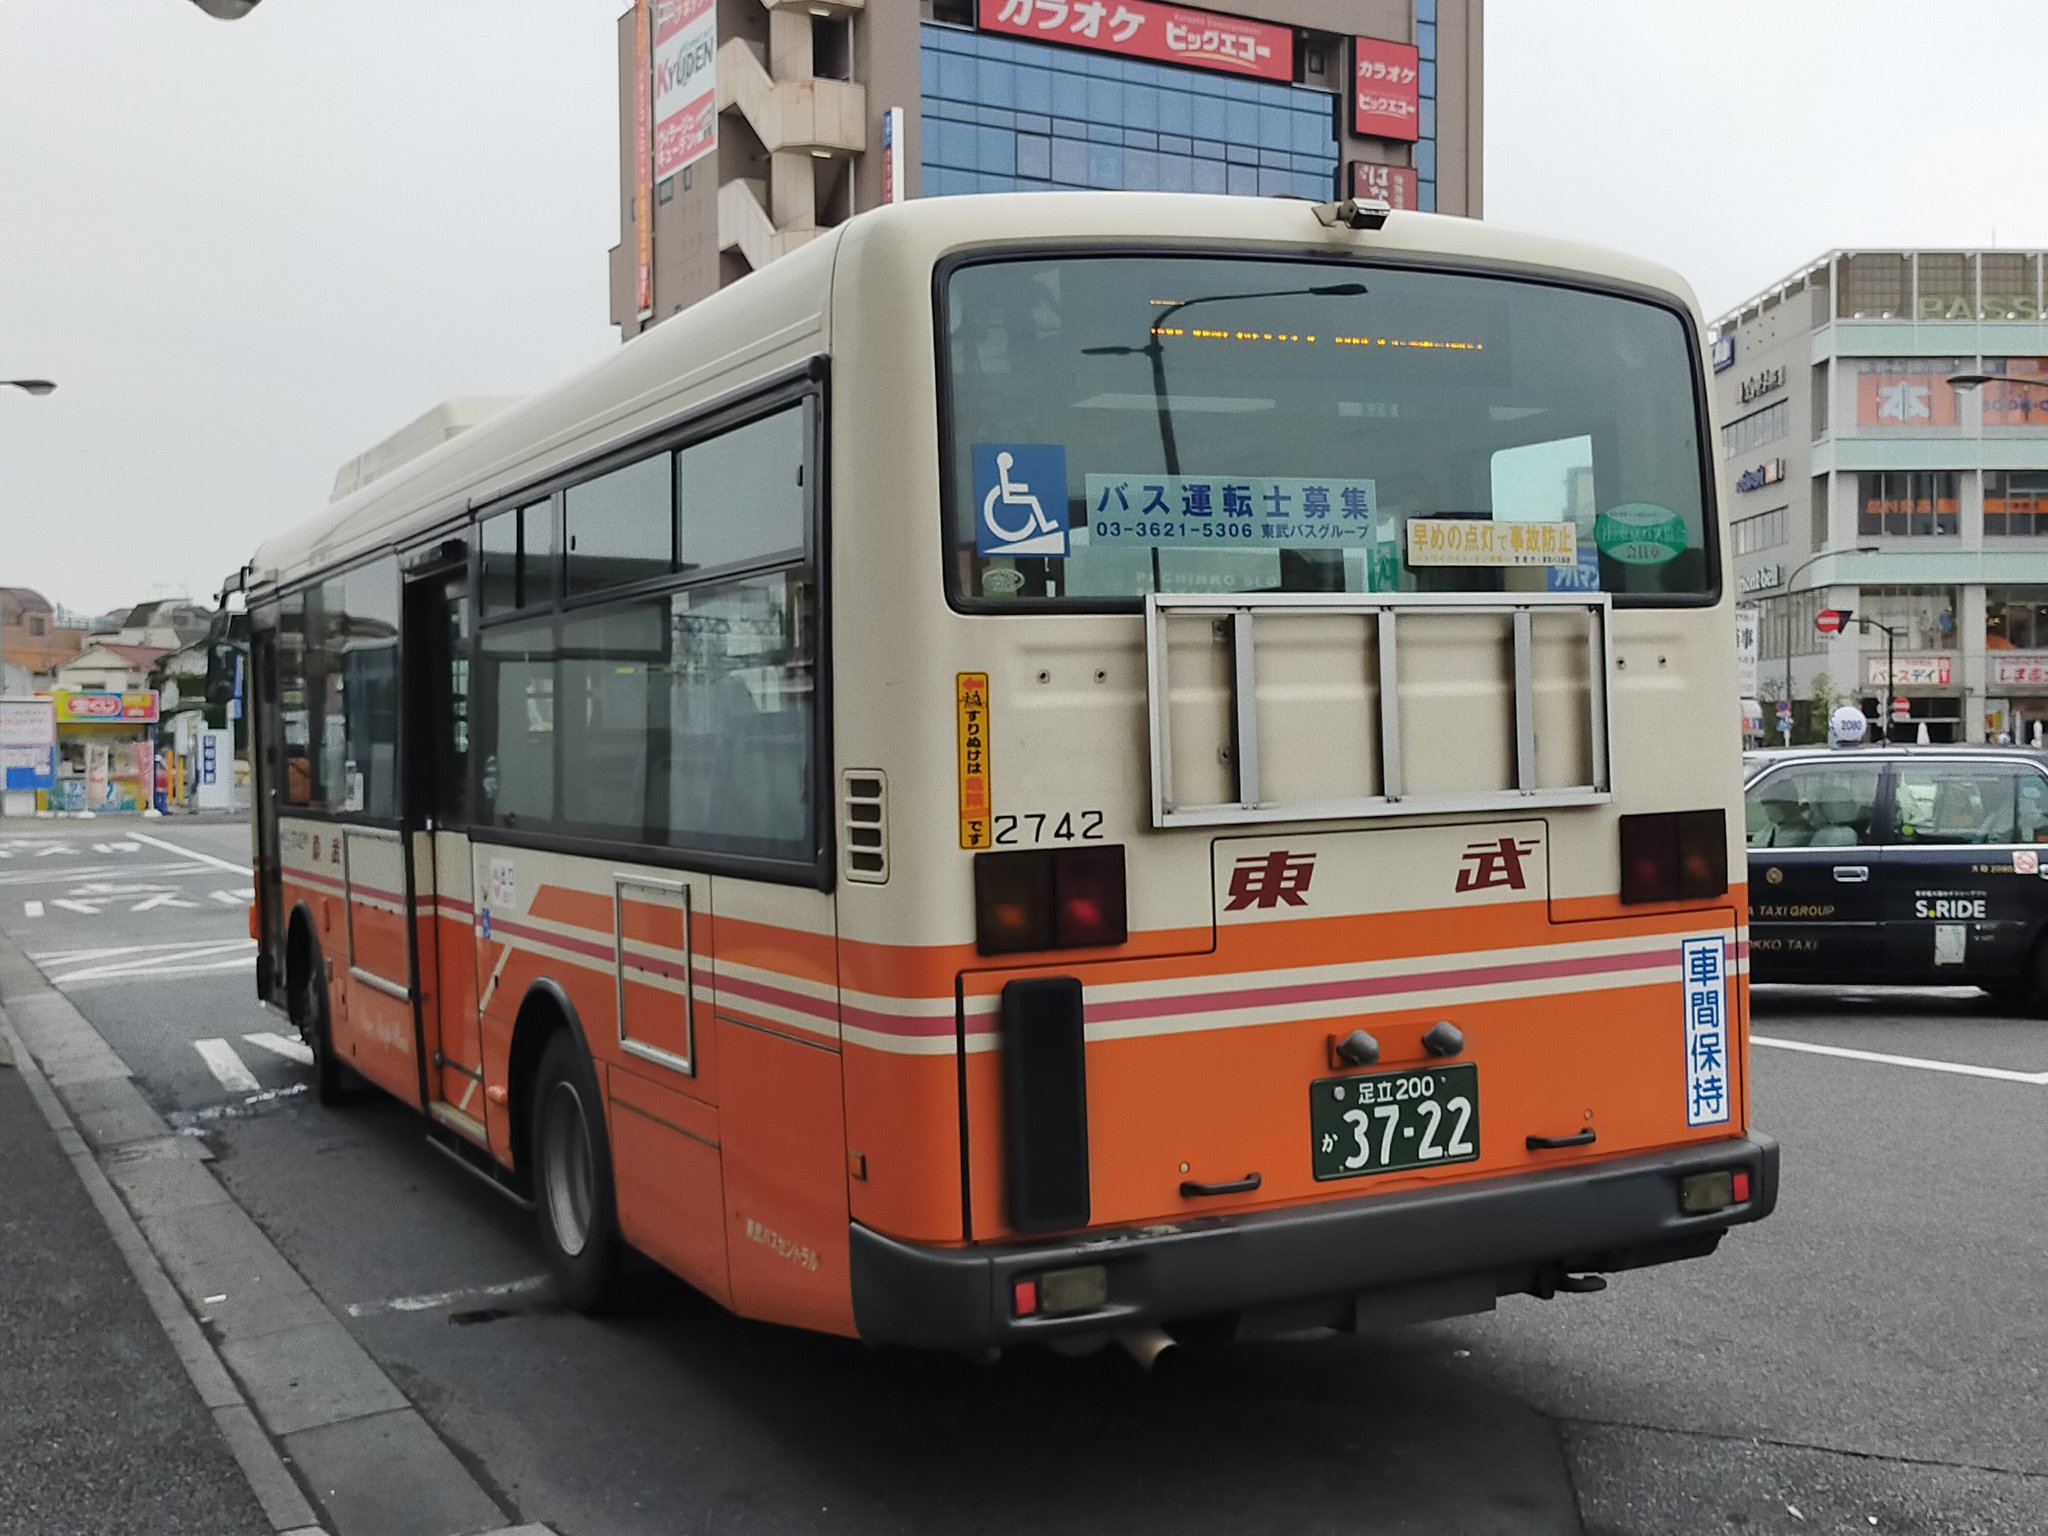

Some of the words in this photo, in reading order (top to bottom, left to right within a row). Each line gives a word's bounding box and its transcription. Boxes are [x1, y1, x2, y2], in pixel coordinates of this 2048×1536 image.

[997, 0, 1145, 43] カラオケ
[1165, 21, 1271, 62] ビッグエコー
[1359, 60, 1414, 84] カラオケ
[1358, 93, 1415, 116] ビッグエコー
[1918, 297, 2048, 320] PASS
[1878, 381, 1931, 422] 本
[1097, 482, 1370, 520] バス運転士募集
[1096, 521, 1253, 539] 03-3621-5306
[1260, 523, 1370, 541] 東武バスグループ
[1412, 523, 1573, 554] 早めの点灯で事故防止
[994, 811, 1105, 844] 2742
[1223, 850, 1317, 911] 東
[1455, 837, 1541, 893] 武
[1760, 905, 1788, 916] TAXI
[1790, 905, 1835, 917] GROUP
[1787, 939, 1818, 951] TAXI
[1689, 946, 1724, 1117] 車間保持
[1358, 1075, 1435, 1105] 足立200
[1321, 1132, 1338, 1154] か
[1342, 1096, 1473, 1169] 37-22
